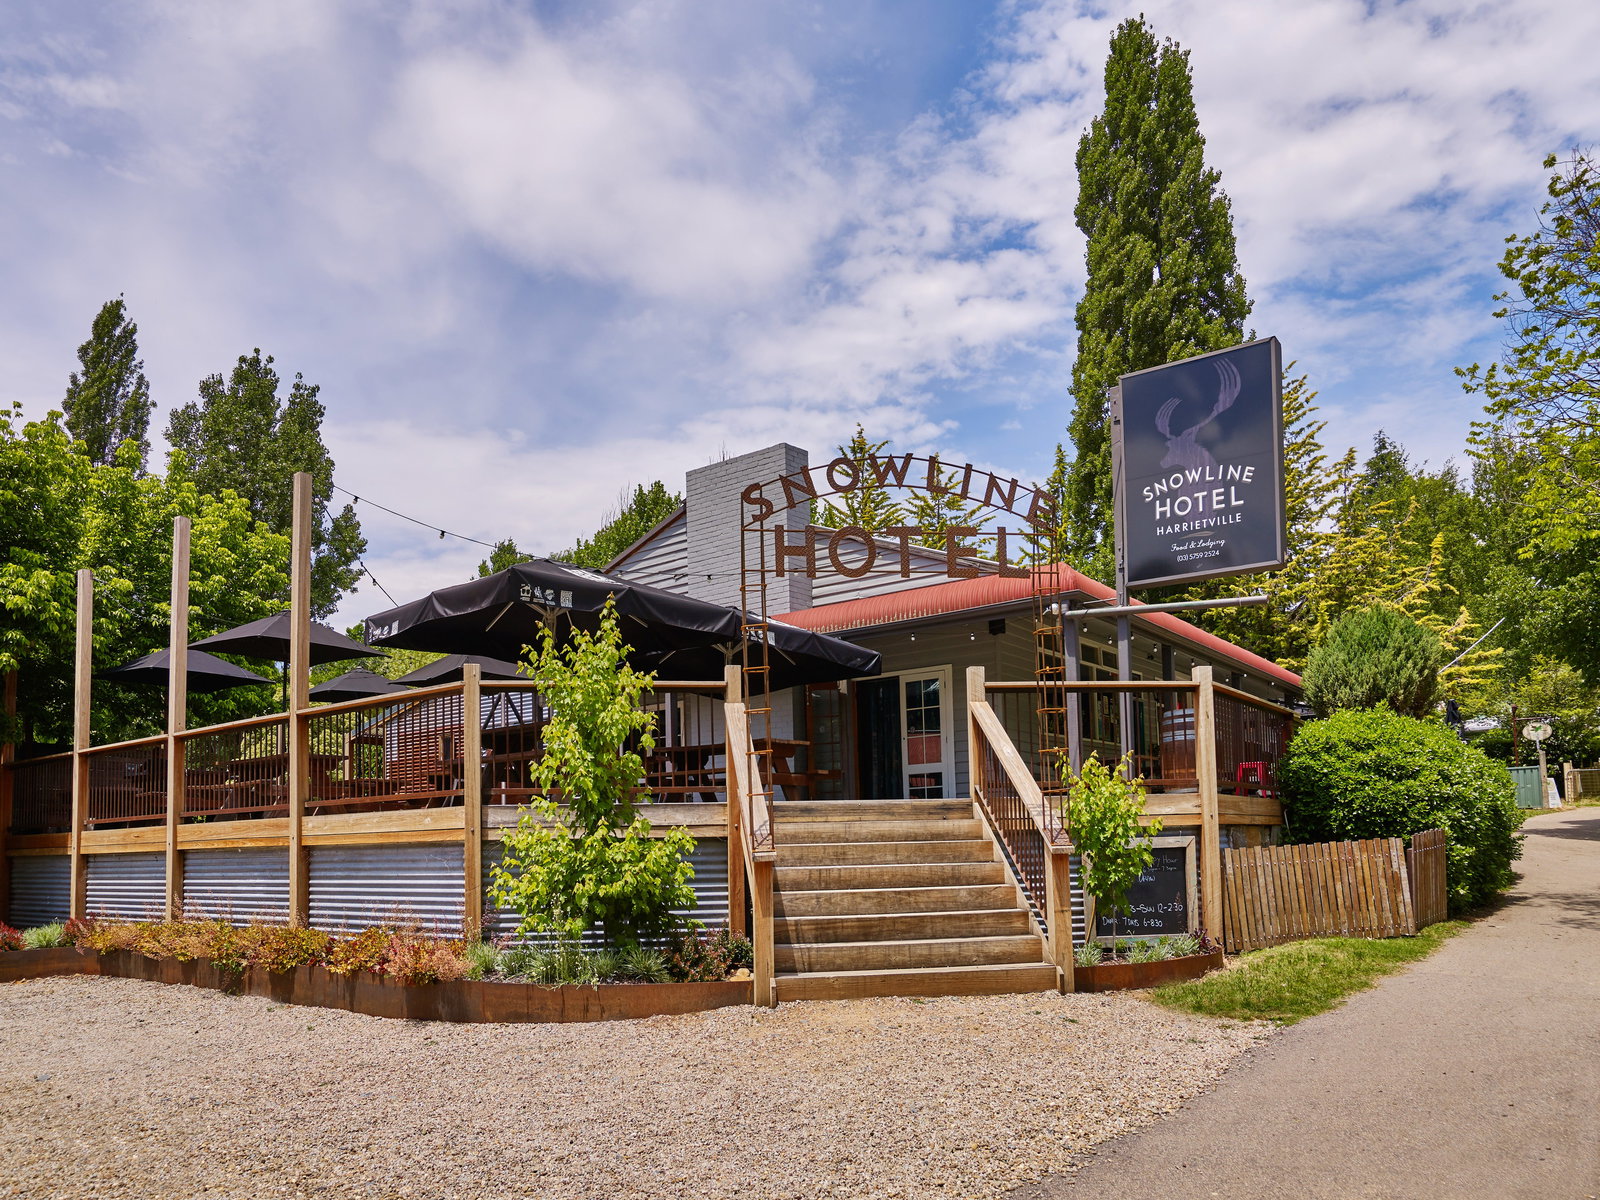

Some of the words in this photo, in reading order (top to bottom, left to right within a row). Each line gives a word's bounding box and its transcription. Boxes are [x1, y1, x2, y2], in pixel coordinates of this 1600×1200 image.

[743, 452, 1056, 532] SNOWLINE
[1143, 464, 1255, 501] SNOWLINE
[1155, 486, 1244, 520] HOTEL
[1156, 513, 1242, 536] HARRIETVILLE
[774, 525, 1031, 578] HOTEL
[1171, 542, 1188, 551] Food
[1197, 538, 1225, 548] Lodging
[1177, 554, 1188, 562] (03)
